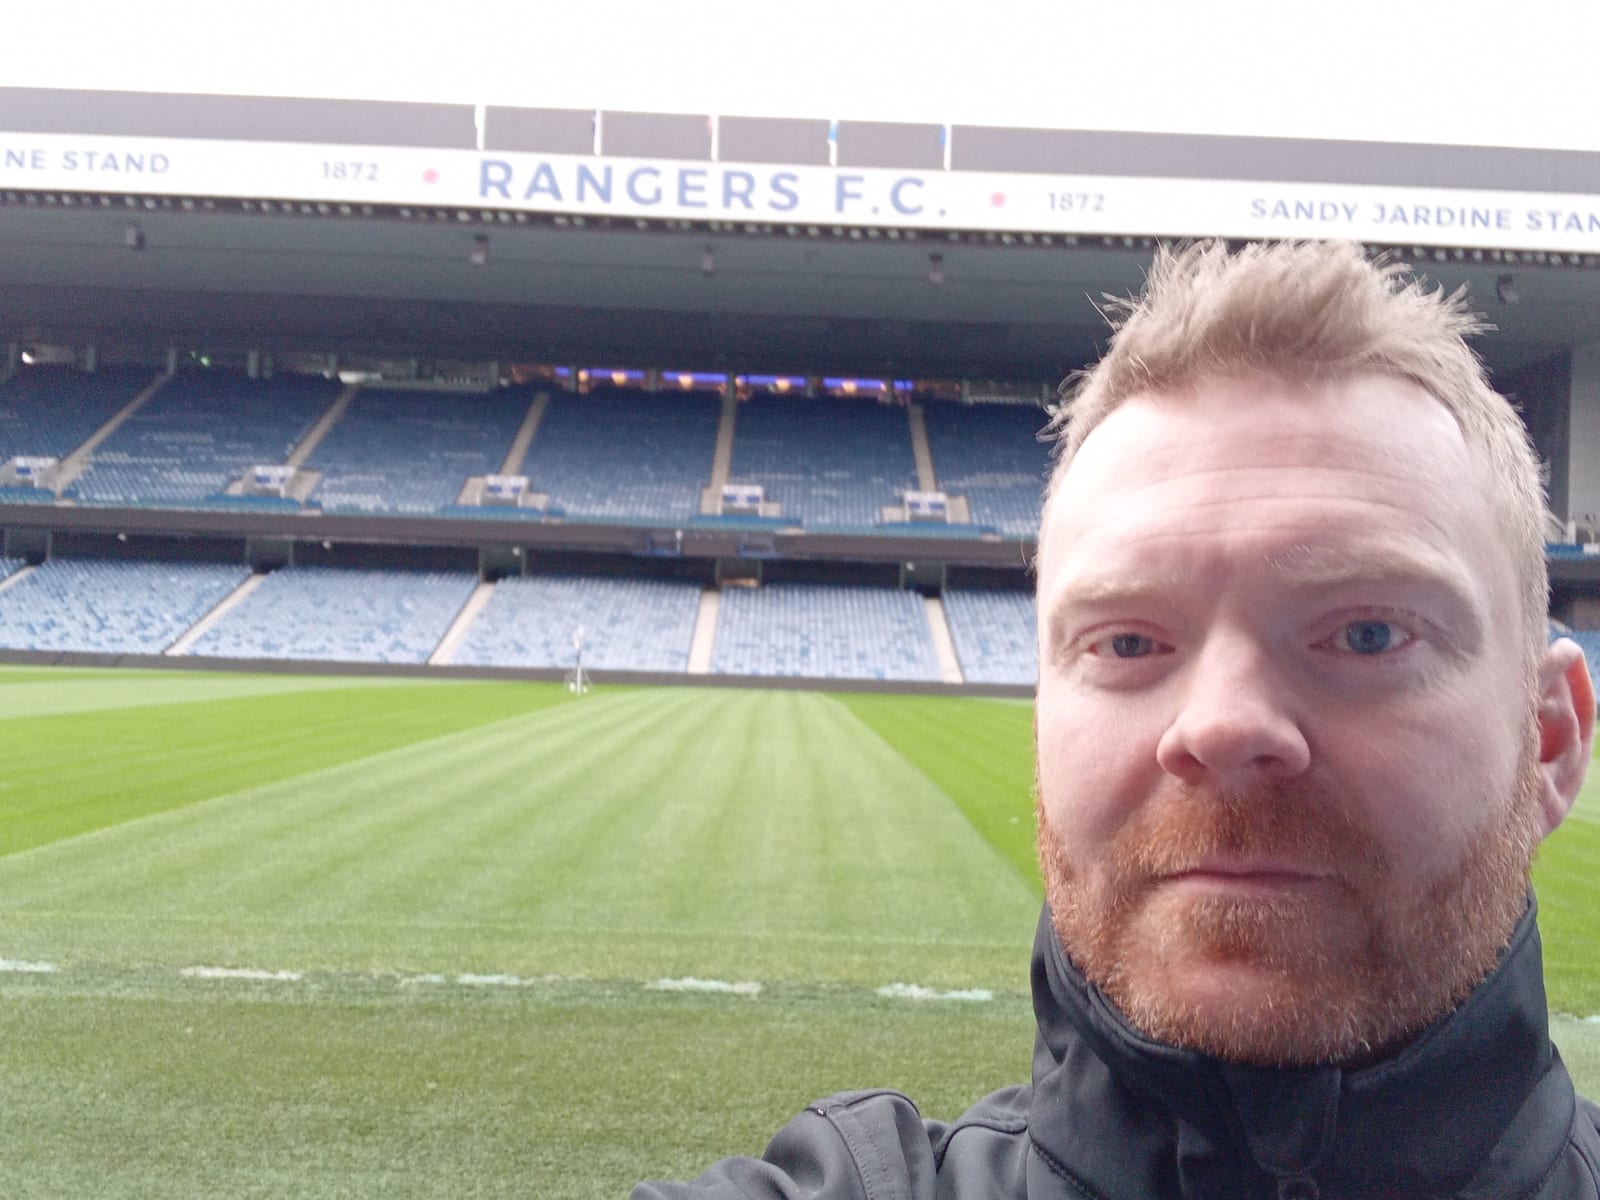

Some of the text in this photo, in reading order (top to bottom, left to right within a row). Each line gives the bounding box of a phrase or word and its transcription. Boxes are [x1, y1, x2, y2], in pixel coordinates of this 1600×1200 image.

[61, 150, 171, 174] STAND
[321, 161, 379, 182] 1872
[477, 157, 949, 217] RANGERS F.C.
[1048, 191, 1105, 212] 1872
[1250, 197, 1359, 222] SANDY
[1372, 203, 1513, 231] JARDINE
